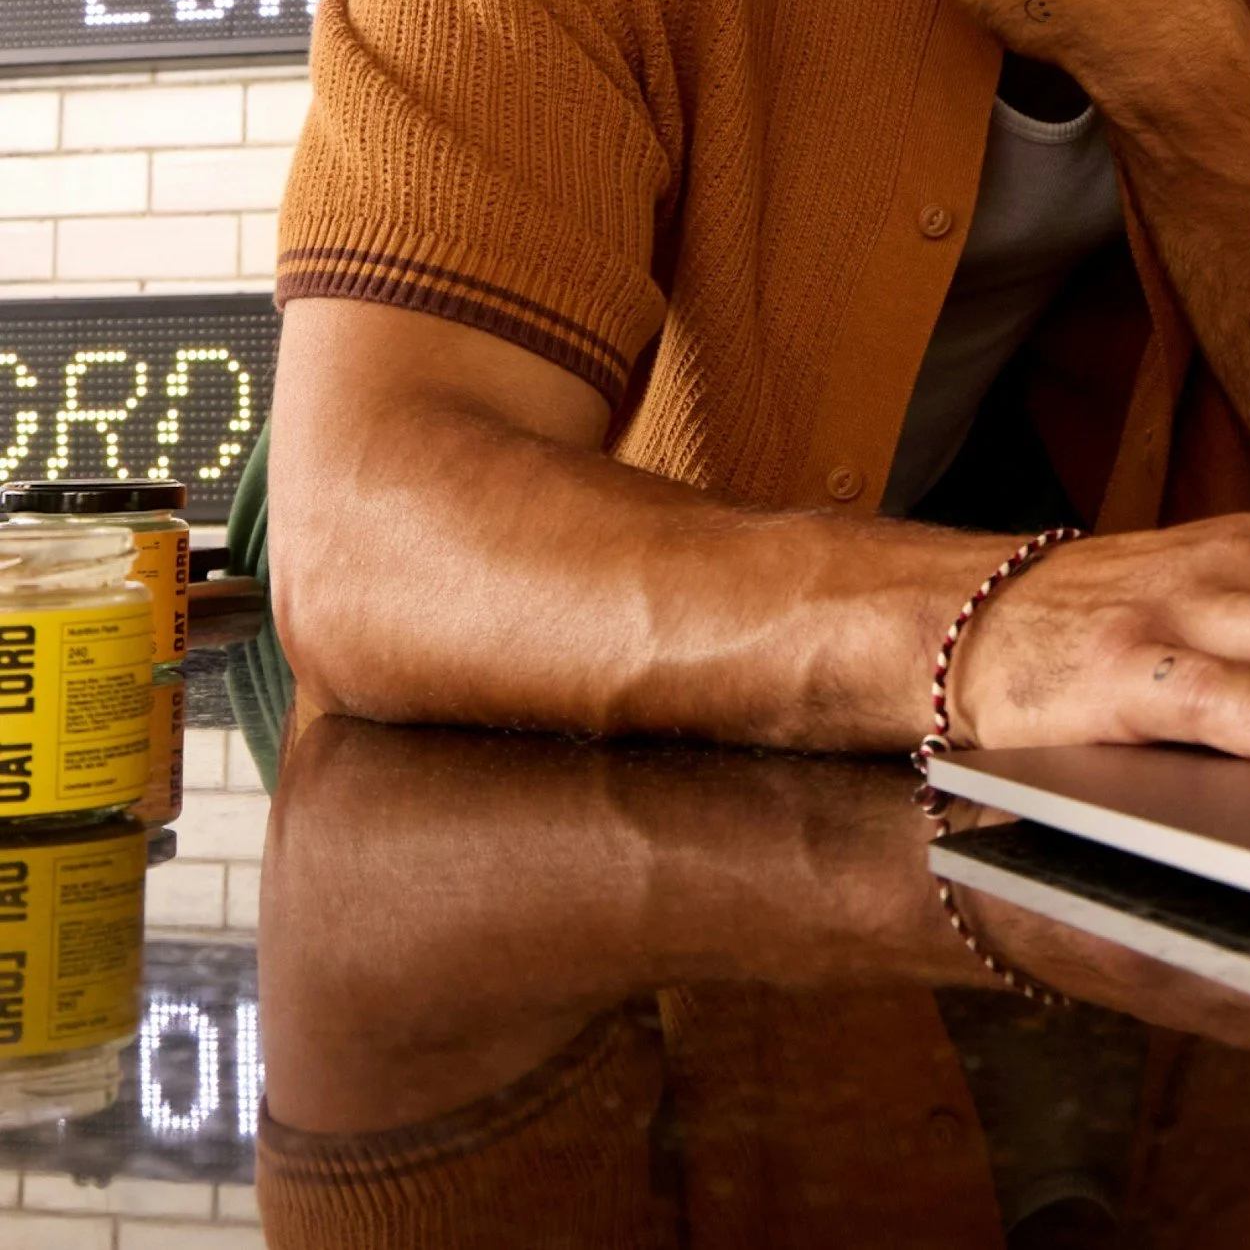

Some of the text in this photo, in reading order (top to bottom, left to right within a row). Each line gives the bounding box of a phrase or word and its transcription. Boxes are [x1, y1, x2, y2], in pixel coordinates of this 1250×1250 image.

[173, 537, 187, 652] OAT LORD
[0, 625, 36, 714] LORD
